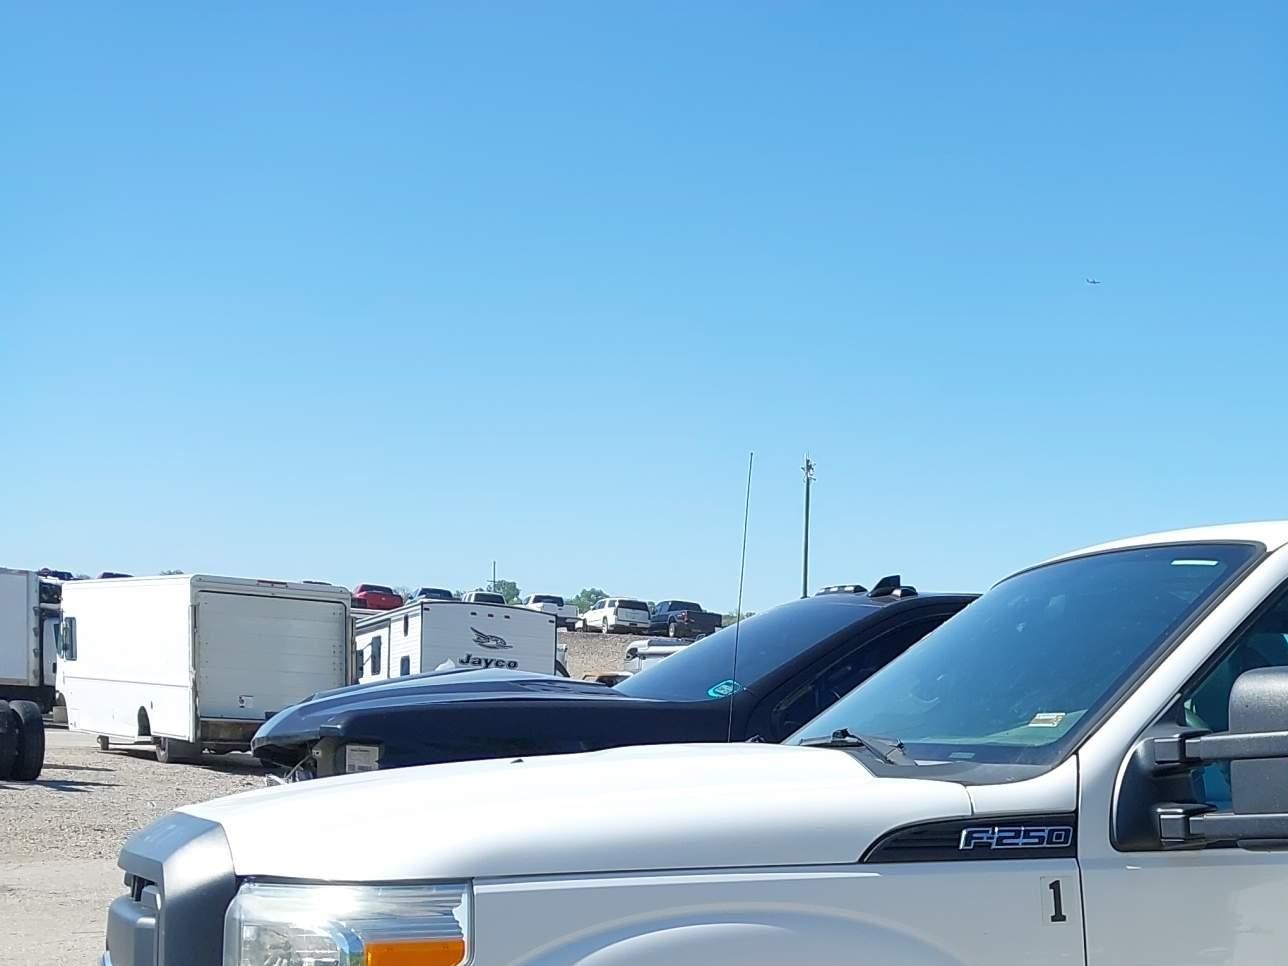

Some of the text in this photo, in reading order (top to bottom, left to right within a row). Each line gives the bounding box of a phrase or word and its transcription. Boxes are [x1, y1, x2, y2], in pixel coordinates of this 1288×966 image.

[458, 653, 519, 669] Jayco
[958, 825, 1074, 851] F-250
[1048, 879, 1067, 923] 1
